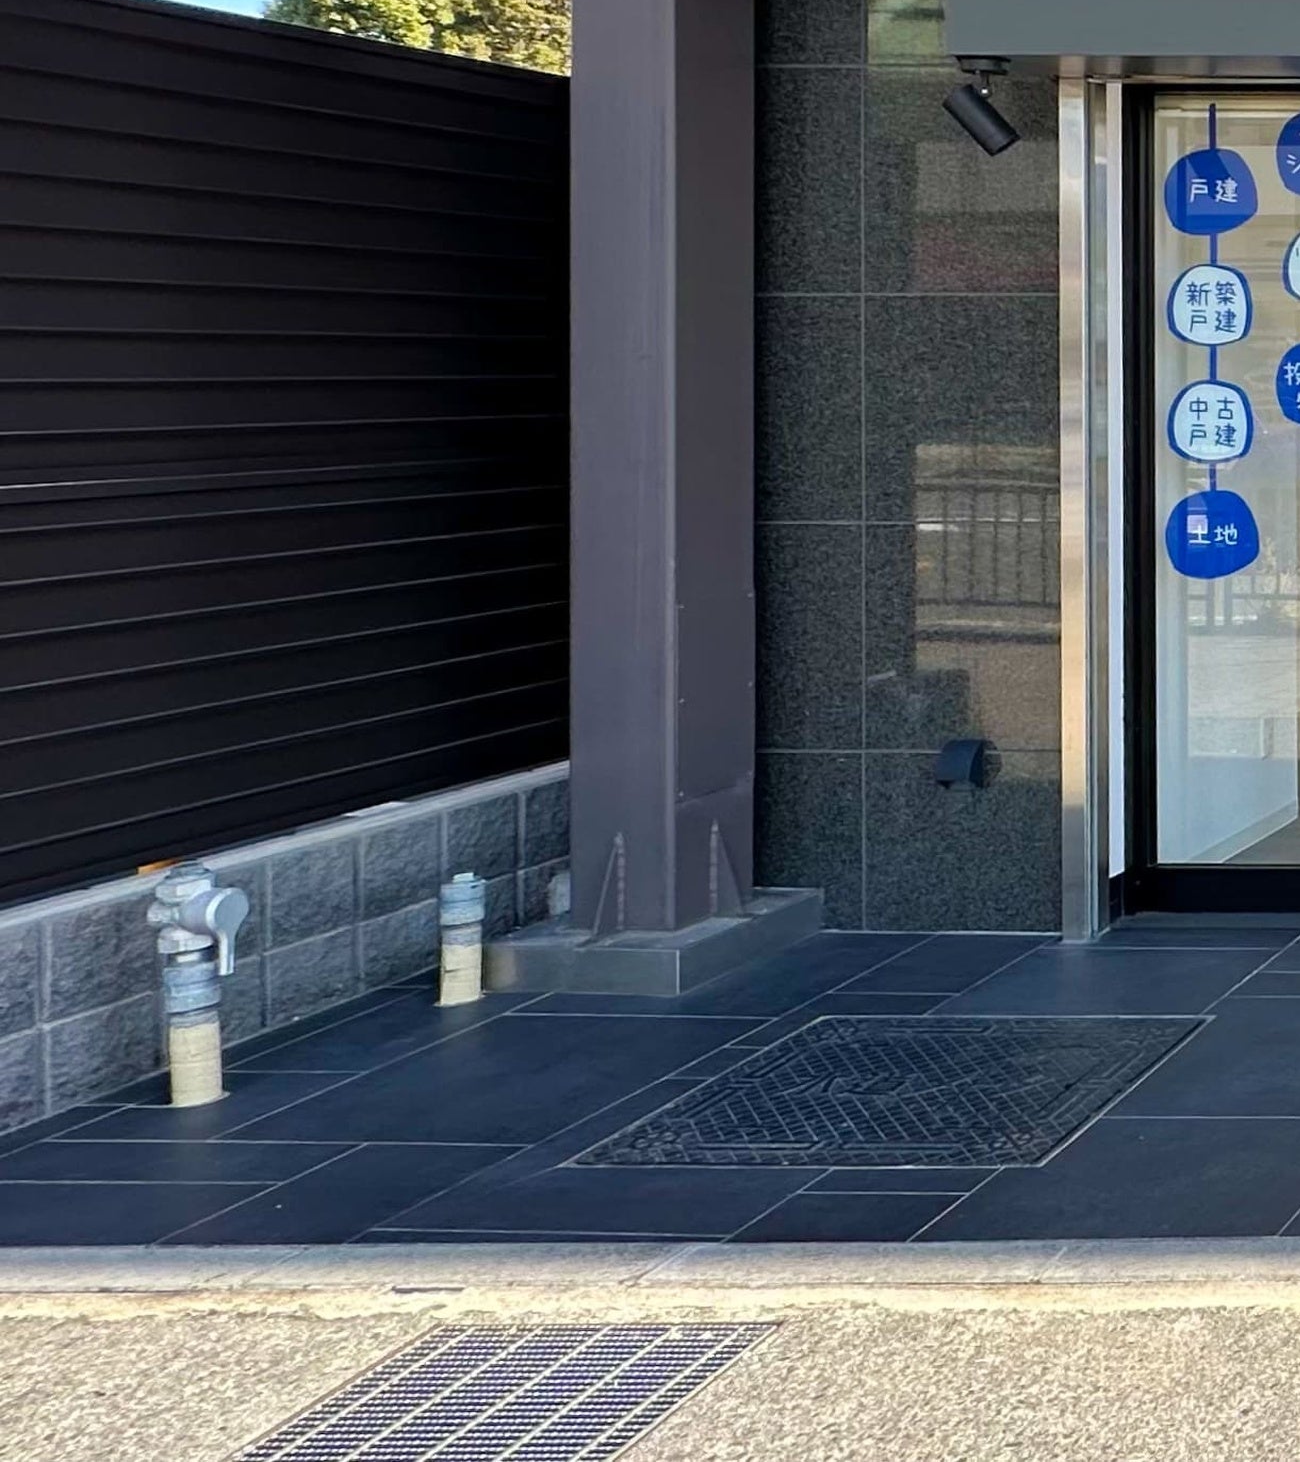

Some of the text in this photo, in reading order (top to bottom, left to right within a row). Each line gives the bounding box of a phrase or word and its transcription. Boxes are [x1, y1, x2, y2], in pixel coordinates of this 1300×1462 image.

[1190, 177, 1238, 203] 戸建
[1186, 281, 1237, 306] 新築
[1189, 308, 1237, 334] 戸建
[1188, 396, 1236, 421] 中古
[1189, 422, 1238, 448] 戸建
[1187, 523, 1238, 546] 土地
